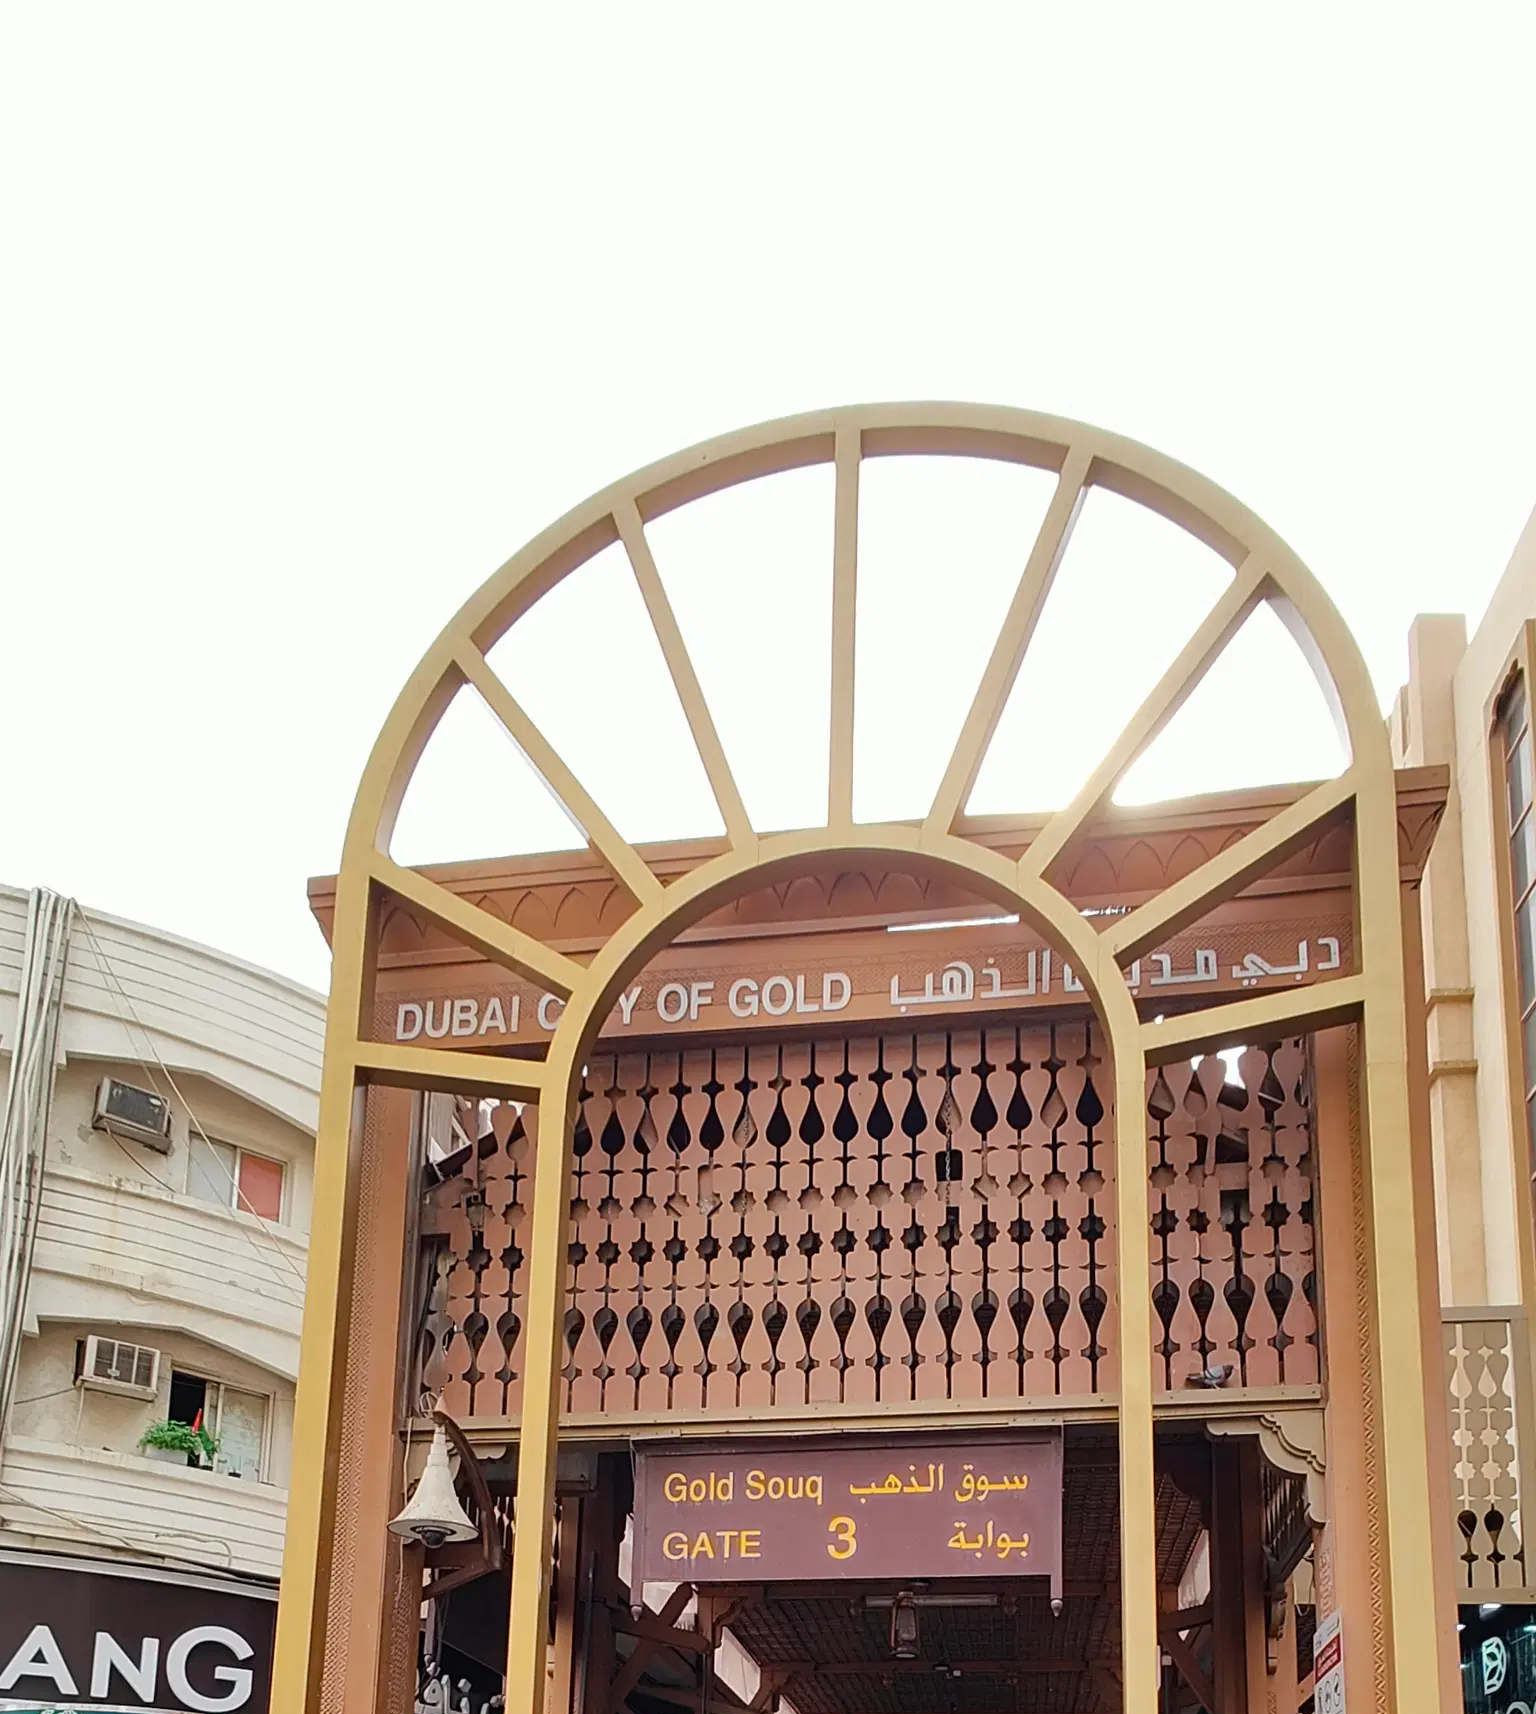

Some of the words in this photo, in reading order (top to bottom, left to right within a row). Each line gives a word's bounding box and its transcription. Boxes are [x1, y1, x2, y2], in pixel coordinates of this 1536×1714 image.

[890, 949, 1051, 1013] الذهب
[1232, 936, 1340, 986] دبي
[396, 996, 520, 1040] DUBAI
[537, 985, 644, 1031] CY
[656, 981, 714, 1024] OF
[728, 972, 853, 1018] GOLD
[664, 1472, 734, 1504] Gold
[745, 1470, 824, 1505] Souq
[849, 1463, 945, 1504] الذهب
[955, 1463, 1030, 1503] سوق
[662, 1530, 762, 1560] GATE
[827, 1515, 858, 1560] 3
[948, 1520, 1031, 1561] بوابة
[0, 1625, 255, 1714] ANG
